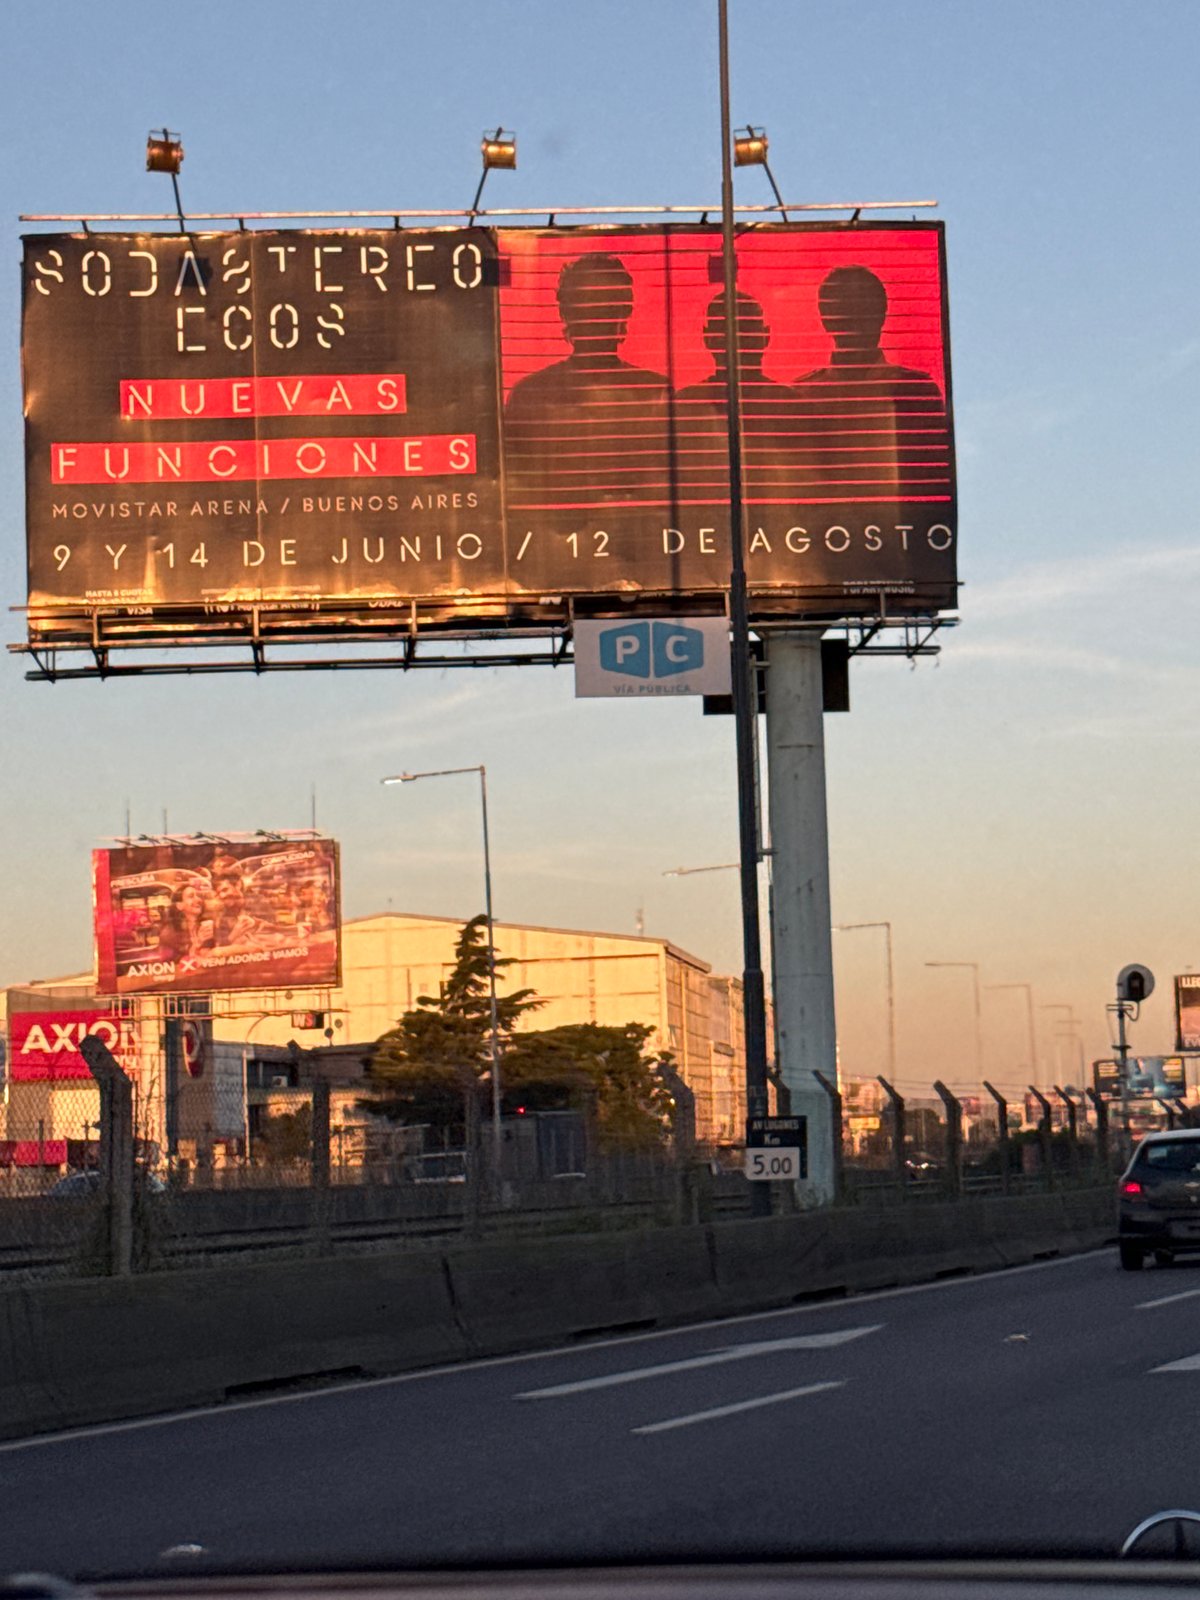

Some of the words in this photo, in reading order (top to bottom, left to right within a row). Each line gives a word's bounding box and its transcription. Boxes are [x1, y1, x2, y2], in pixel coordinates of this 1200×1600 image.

[177, 303, 345, 352] ECOS
[128, 379, 399, 416] NUEVAS
[59, 438, 471, 480] FUNCIONES
[52, 502, 177, 519] MOVISTAR
[190, 499, 269, 517] ARENA
[303, 496, 399, 513] BUENOS
[411, 492, 478, 510] AIRES
[53, 544, 71, 571] 9
[105, 543, 127, 570] Y
[162, 542, 208, 569] 14
[243, 538, 297, 567] DE
[331, 533, 482, 563] JUNIO
[566, 530, 609, 558] 12
[663, 528, 716, 554] DE
[750, 524, 952, 554] AGOSTO
[127, 962, 175, 978] AXION
[20, 1021, 139, 1055] AXION
[764, 1133, 780, 1145] Km
[753, 1154, 793, 1177] 5.00
